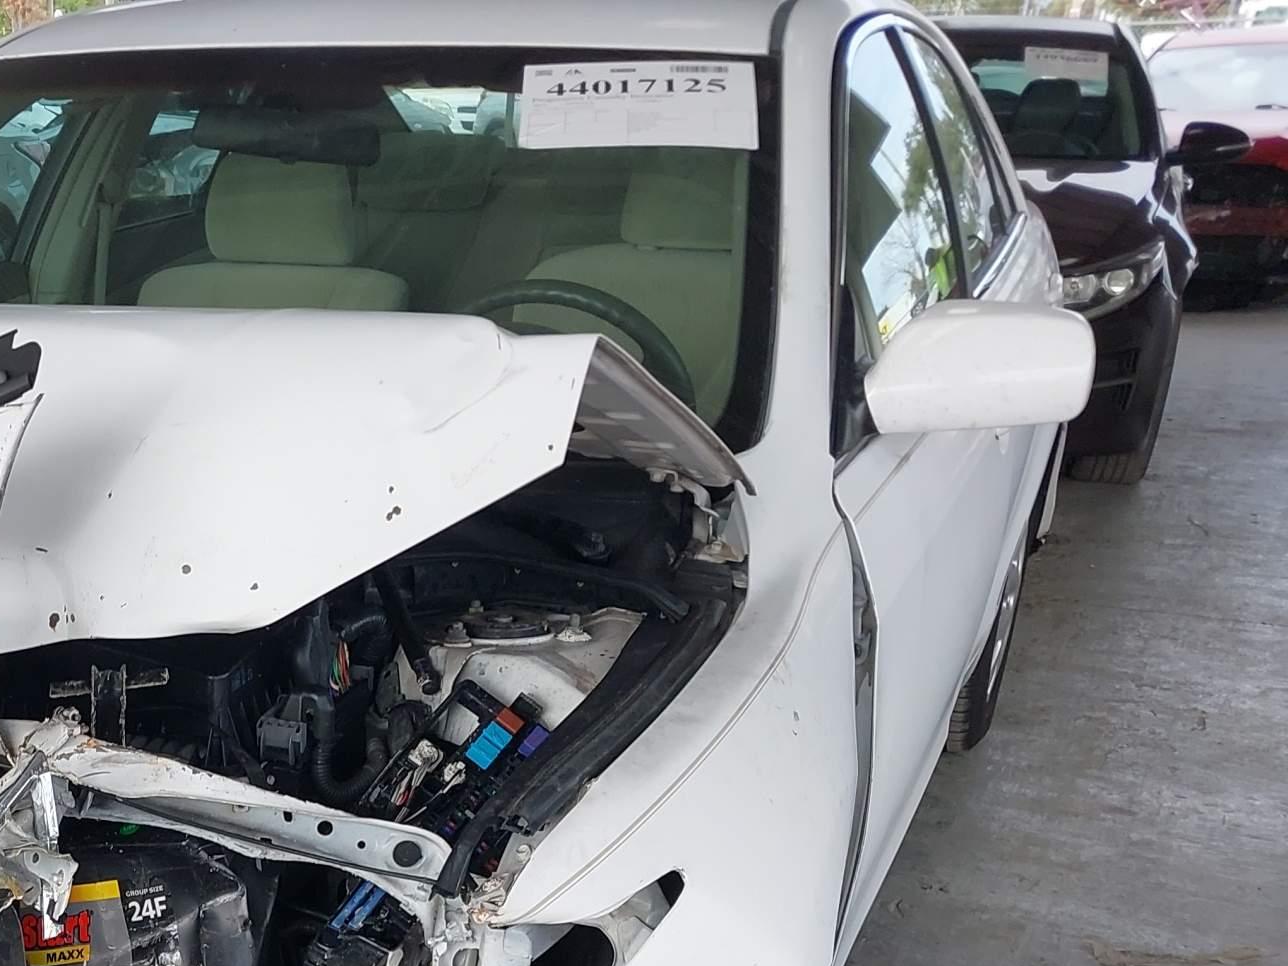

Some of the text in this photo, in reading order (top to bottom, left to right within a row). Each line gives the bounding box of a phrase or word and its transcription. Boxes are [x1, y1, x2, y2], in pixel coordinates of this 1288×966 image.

[546, 79, 727, 96] 44017125
[125, 884, 164, 897] GROUP SIZE
[128, 895, 167, 922] 24F
[46, 948, 85, 964] MAXX
